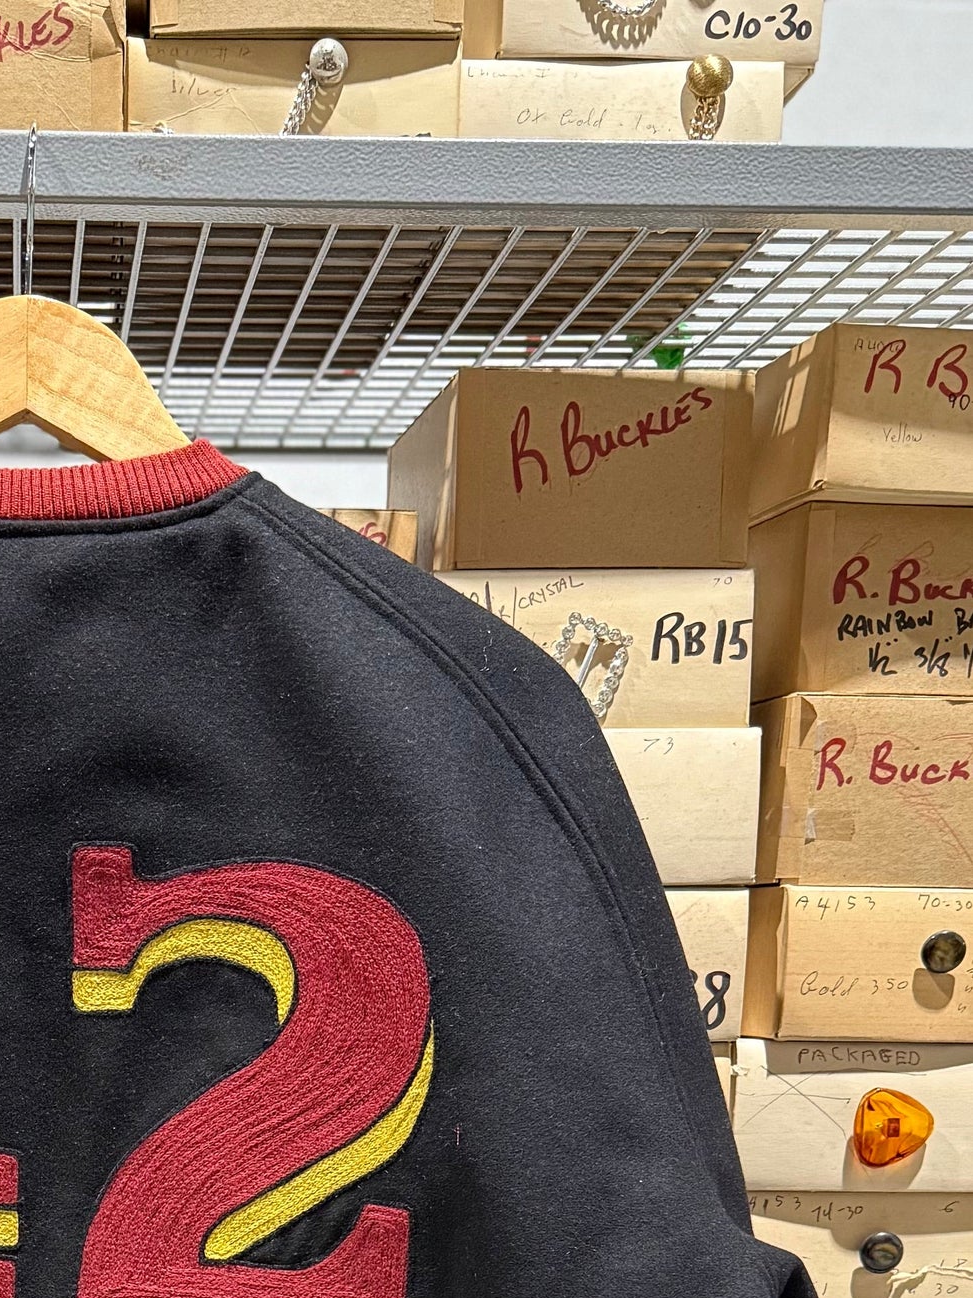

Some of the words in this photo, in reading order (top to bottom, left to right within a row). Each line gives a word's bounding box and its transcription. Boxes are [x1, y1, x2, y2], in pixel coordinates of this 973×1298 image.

[863, 338, 907, 395] R
[509, 405, 549, 494] R
[883, 421, 923, 443] Yellow
[651, 611, 753, 665] RB15
[797, 1046, 921, 1067] PACKAGED
